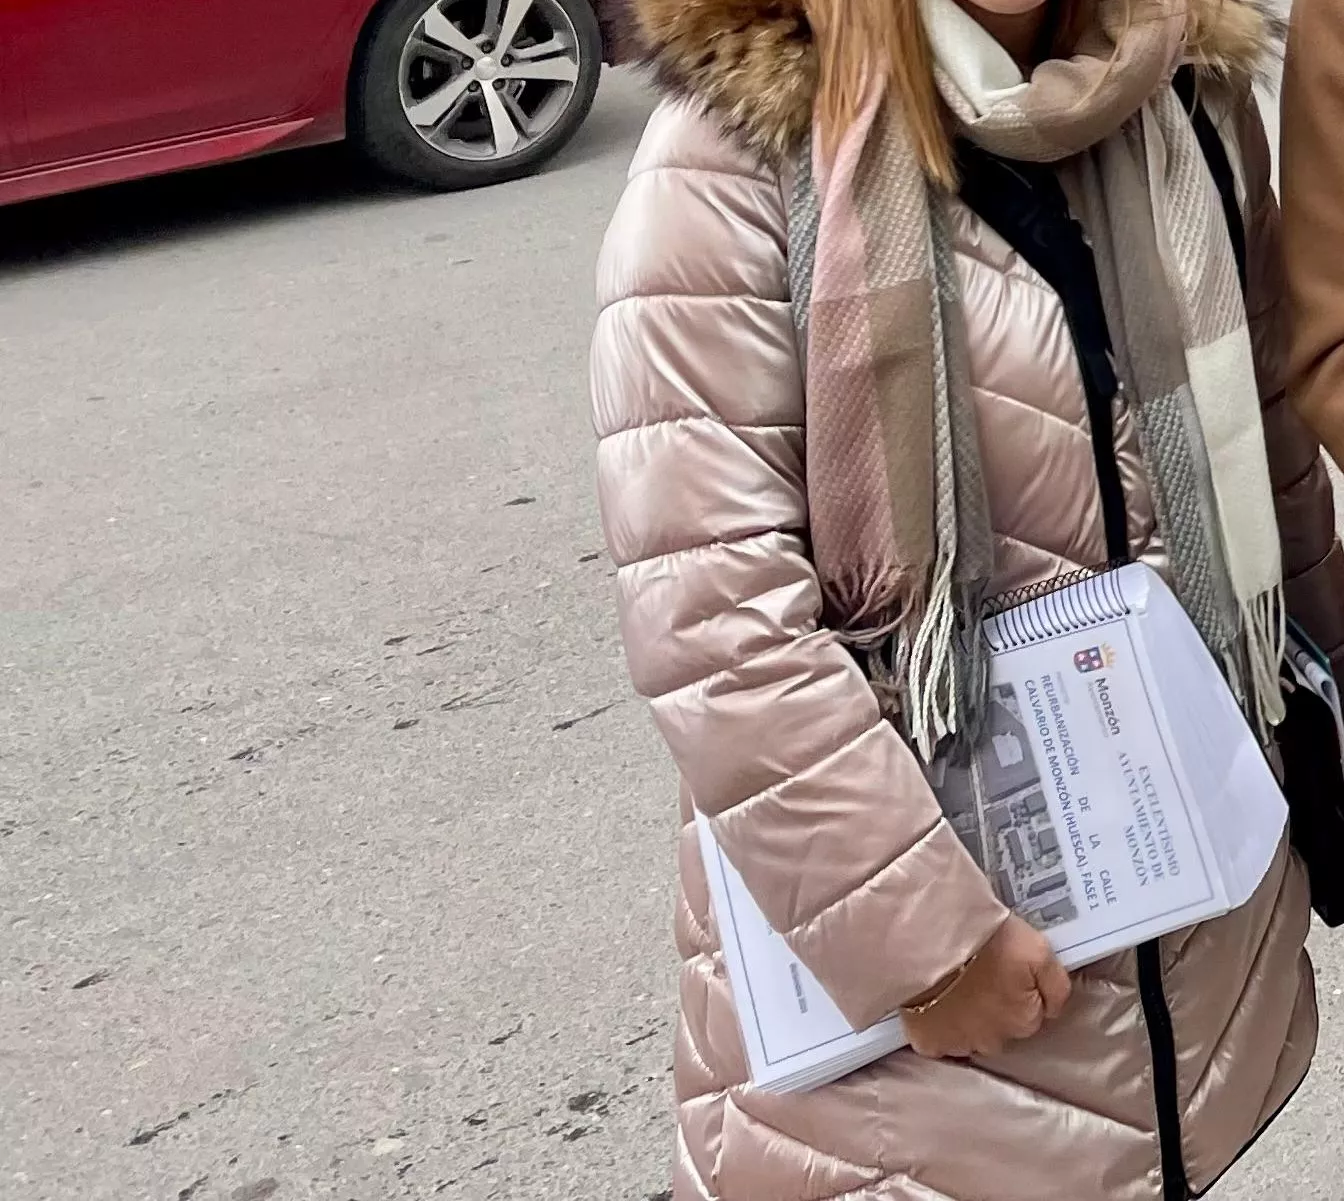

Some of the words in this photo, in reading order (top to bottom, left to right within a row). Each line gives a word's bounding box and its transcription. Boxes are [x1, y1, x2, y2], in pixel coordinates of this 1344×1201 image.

[1025, 679, 1050, 735] CALVARIO
[1096, 677, 1121, 737] Monzón
[1042, 737, 1056, 755] DE
[1040, 674, 1080, 776] REURBANIZACIÓN
[1078, 796, 1091, 813] DE
[1088, 833, 1100, 850] LA
[1099, 869, 1118, 904] CALLE
[1047, 755, 1071, 811] MONZÓN
[1118, 751, 1159, 861] AYUNTAMIENTO
[1152, 862, 1166, 882] DE
[1139, 765, 1181, 877] EXCELENTÍSIMO
[1124, 824, 1150, 887] MONZÓN
[1081, 871, 1098, 903] FASE
[1089, 902, 1099, 911] 1
